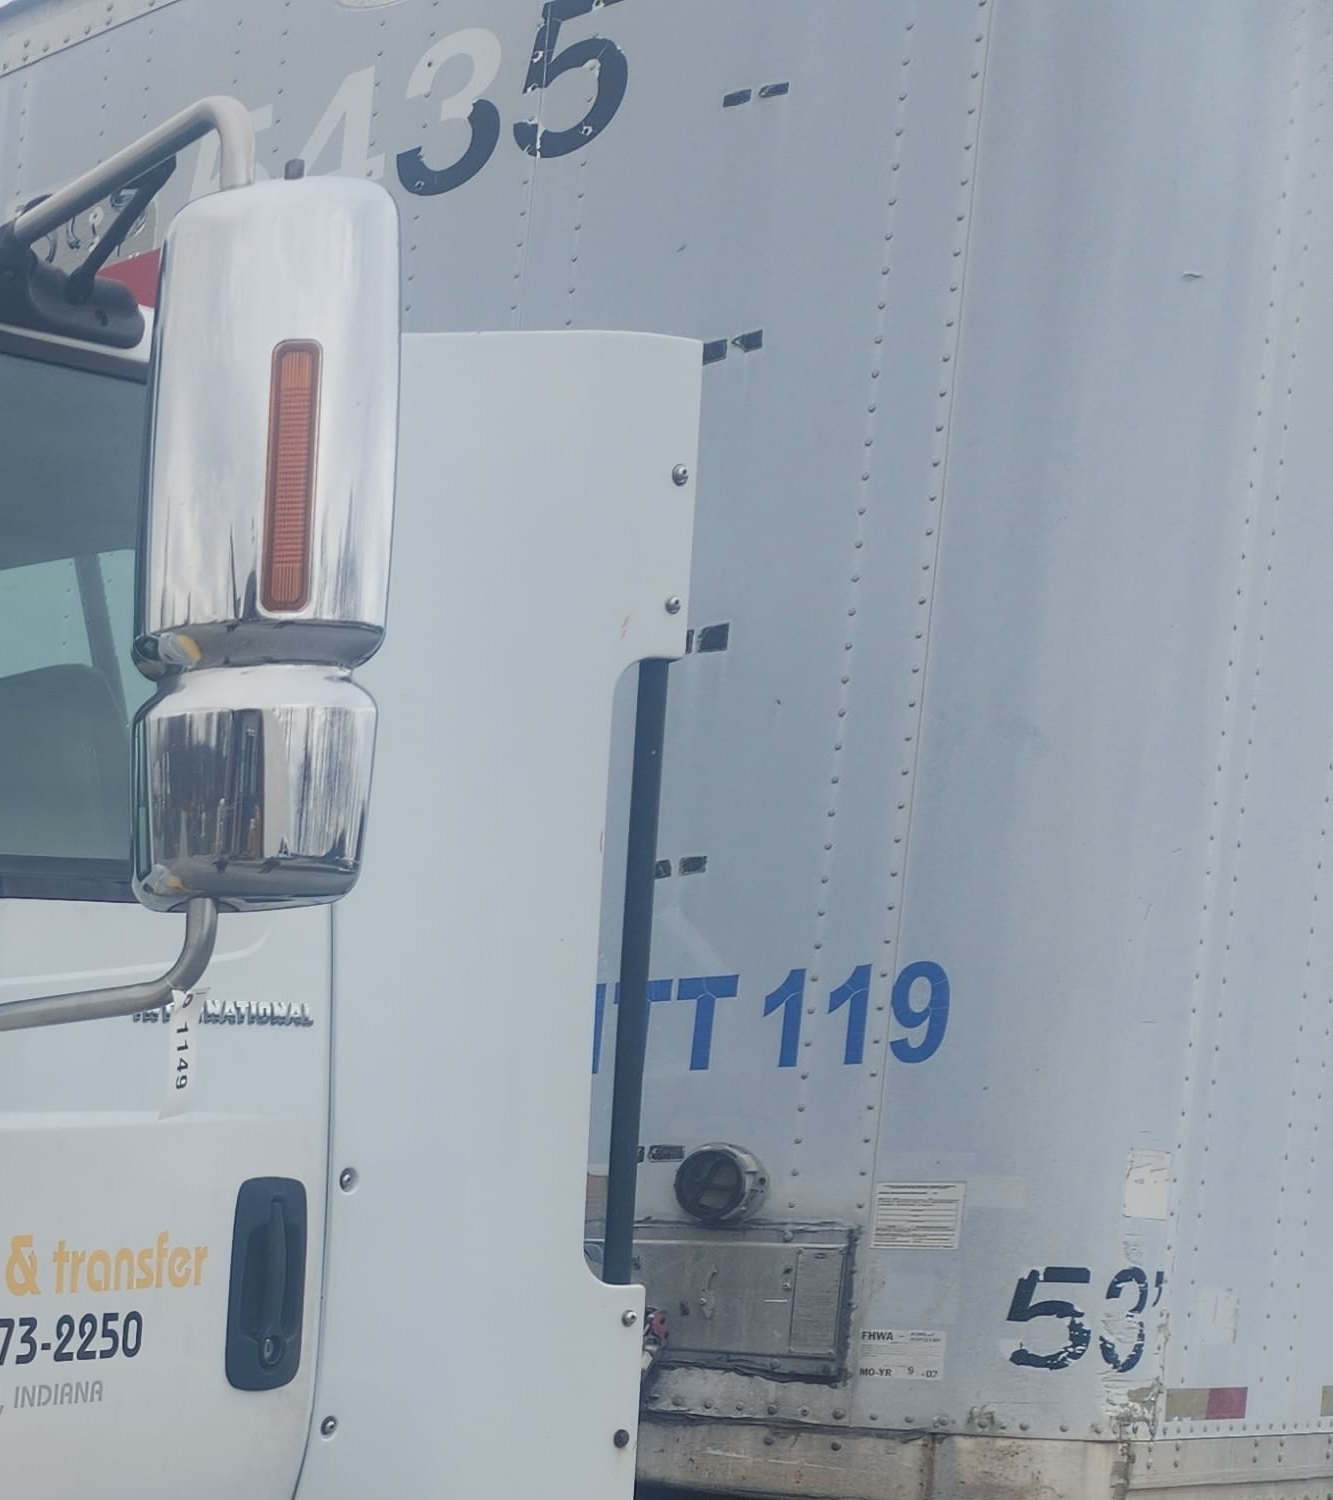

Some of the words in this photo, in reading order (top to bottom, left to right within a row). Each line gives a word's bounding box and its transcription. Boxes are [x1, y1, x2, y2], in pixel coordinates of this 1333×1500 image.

[763, 961, 951, 1067] 119
[6, 1235, 41, 1296] &
[53, 1231, 208, 1294] transfer
[861, 1330, 894, 1341] FHWA
[13, 1380, 105, 1410] INDIANA
